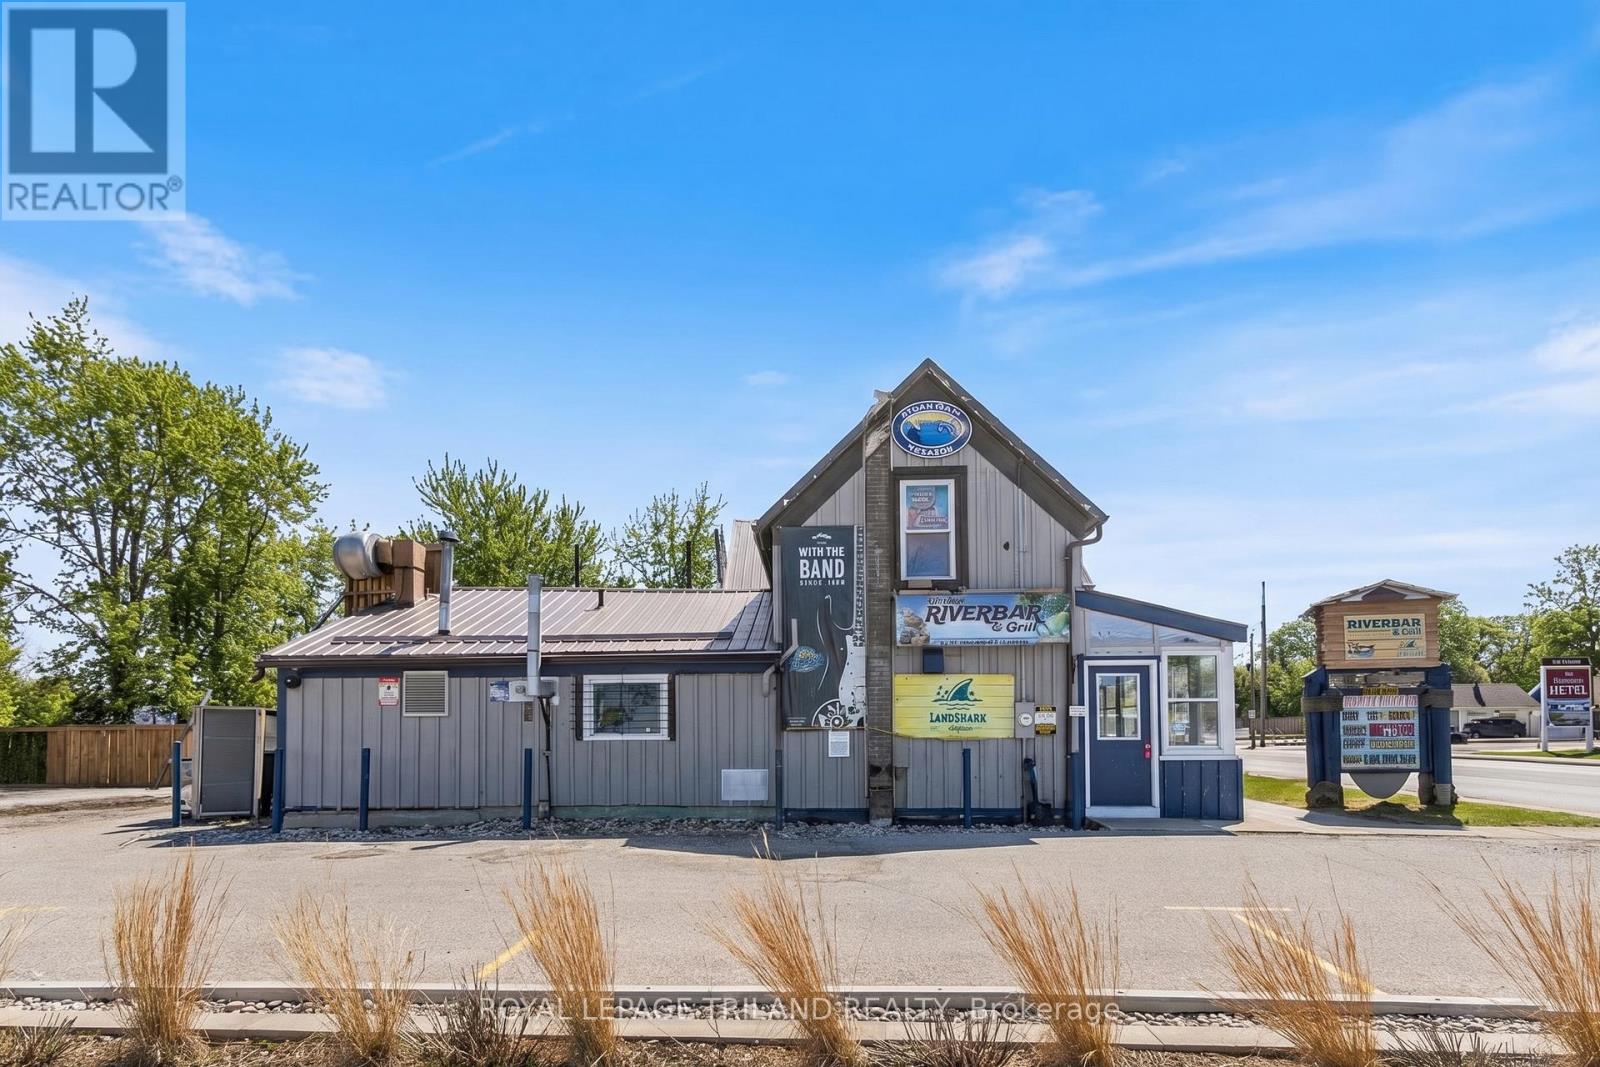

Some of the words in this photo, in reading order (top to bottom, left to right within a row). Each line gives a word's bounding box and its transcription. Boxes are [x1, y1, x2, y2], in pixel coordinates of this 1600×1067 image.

[798, 546, 824, 557] WITH
[825, 546, 845, 557] THE
[800, 558, 845, 579] BAND
[925, 605, 1045, 625] RIVERBAR
[1006, 621, 1037, 633] Grill
[1346, 617, 1422, 629] RIVERBAR
